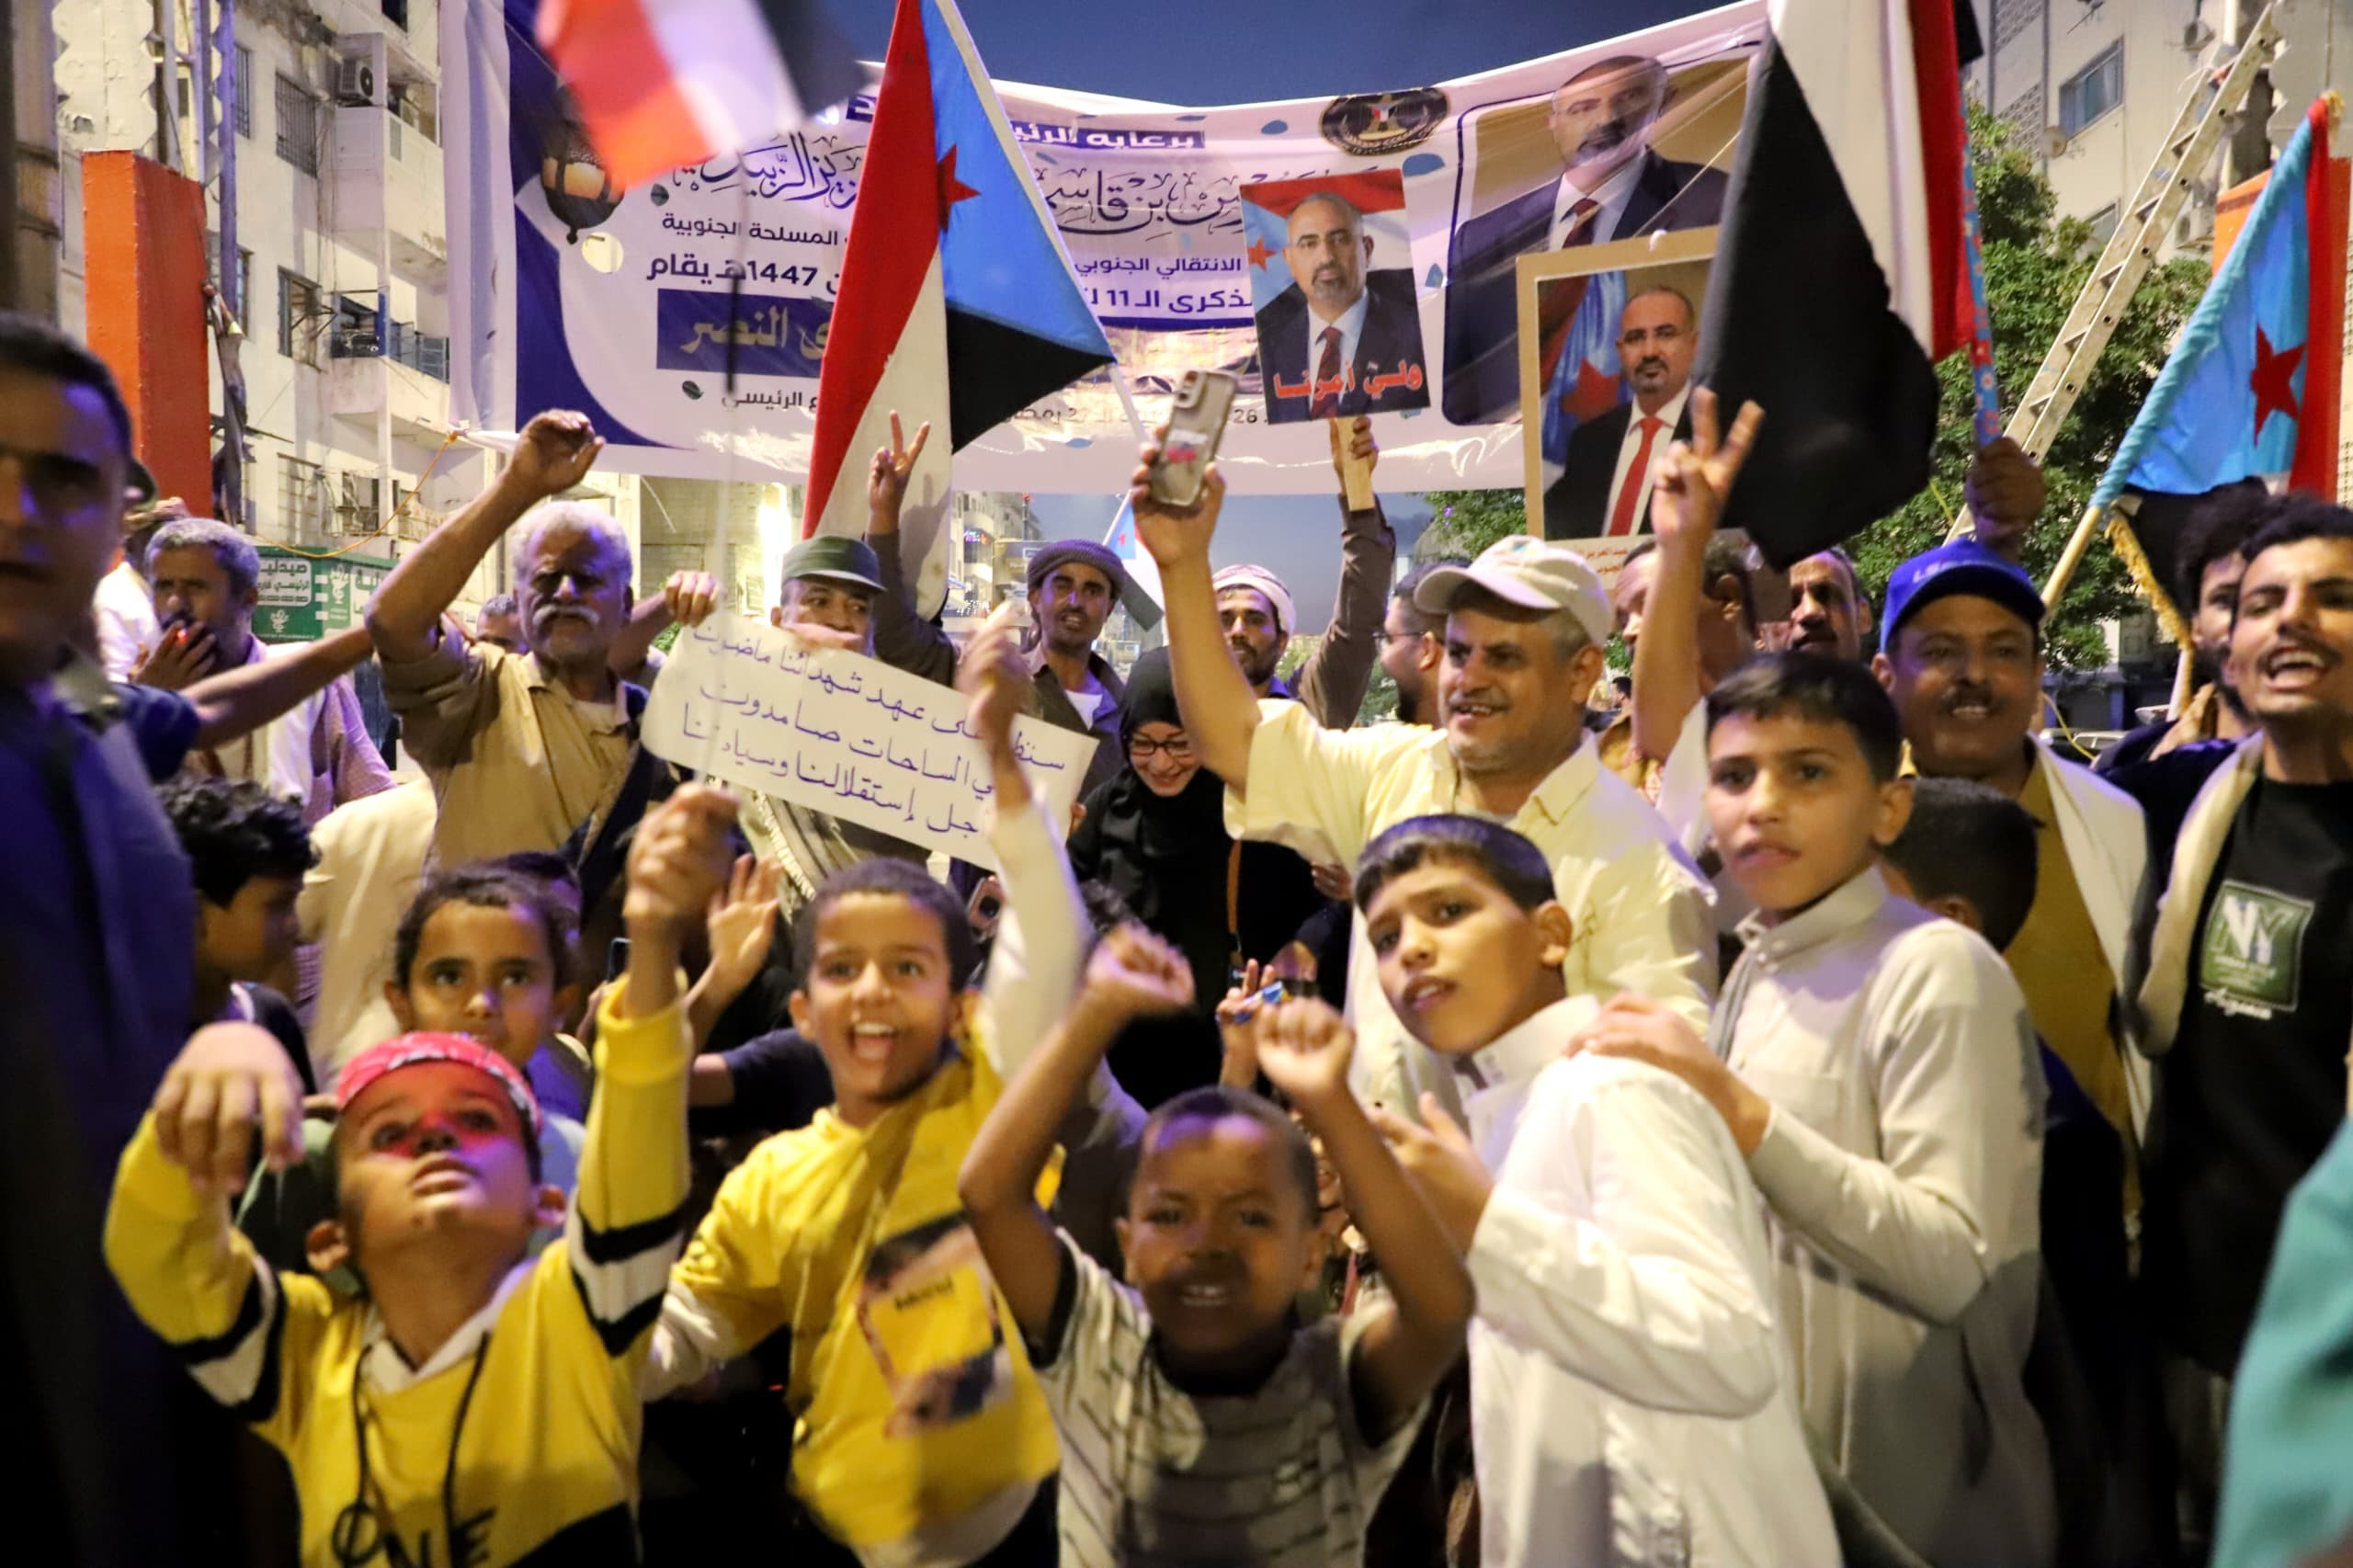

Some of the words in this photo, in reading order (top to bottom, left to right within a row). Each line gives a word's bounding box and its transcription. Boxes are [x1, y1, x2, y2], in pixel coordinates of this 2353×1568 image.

[662, 212, 742, 239] الجنوبية
[748, 222, 839, 245] المسلحة
[647, 253, 712, 285] يقام
[1074, 256, 1150, 277] الجنوبي
[1156, 256, 1242, 280] الانتقالي
[1168, 289, 1252, 313] ذكرى
[680, 305, 789, 354] النصر
[1273, 360, 1356, 401] أمرنا
[1363, 358, 1423, 400] ولي
[259, 558, 308, 576] صيدلي
[866, 688, 925, 722] عهد
[1014, 731, 1064, 770] سنظ
